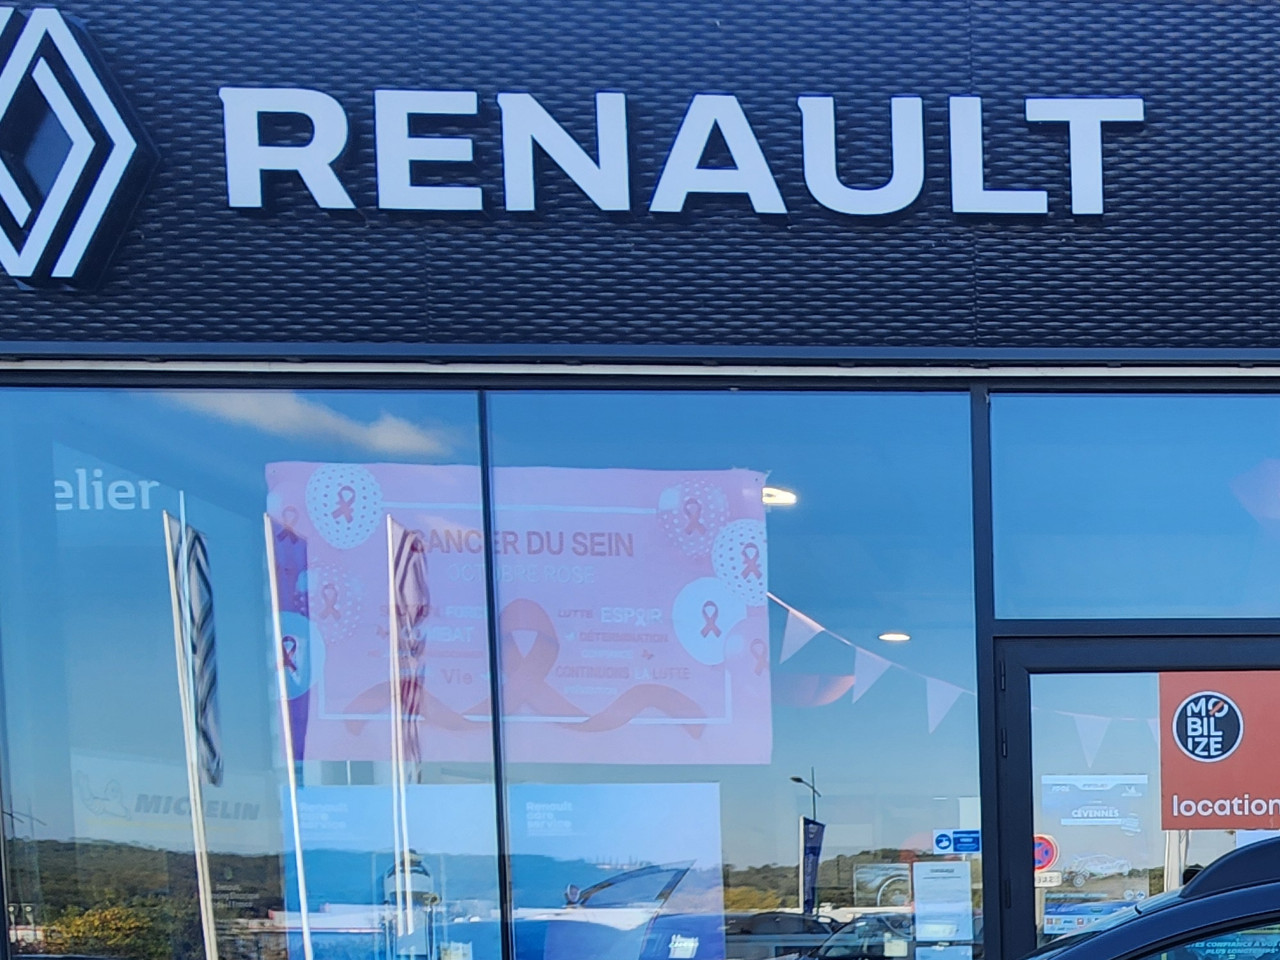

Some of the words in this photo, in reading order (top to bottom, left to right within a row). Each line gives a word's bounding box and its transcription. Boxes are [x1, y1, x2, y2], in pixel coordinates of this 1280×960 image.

[218, 86, 1145, 216] RENAULT
[526, 531, 564, 556] DU
[571, 532, 635, 558] SEIN
[134, 793, 261, 821] MICELIN
